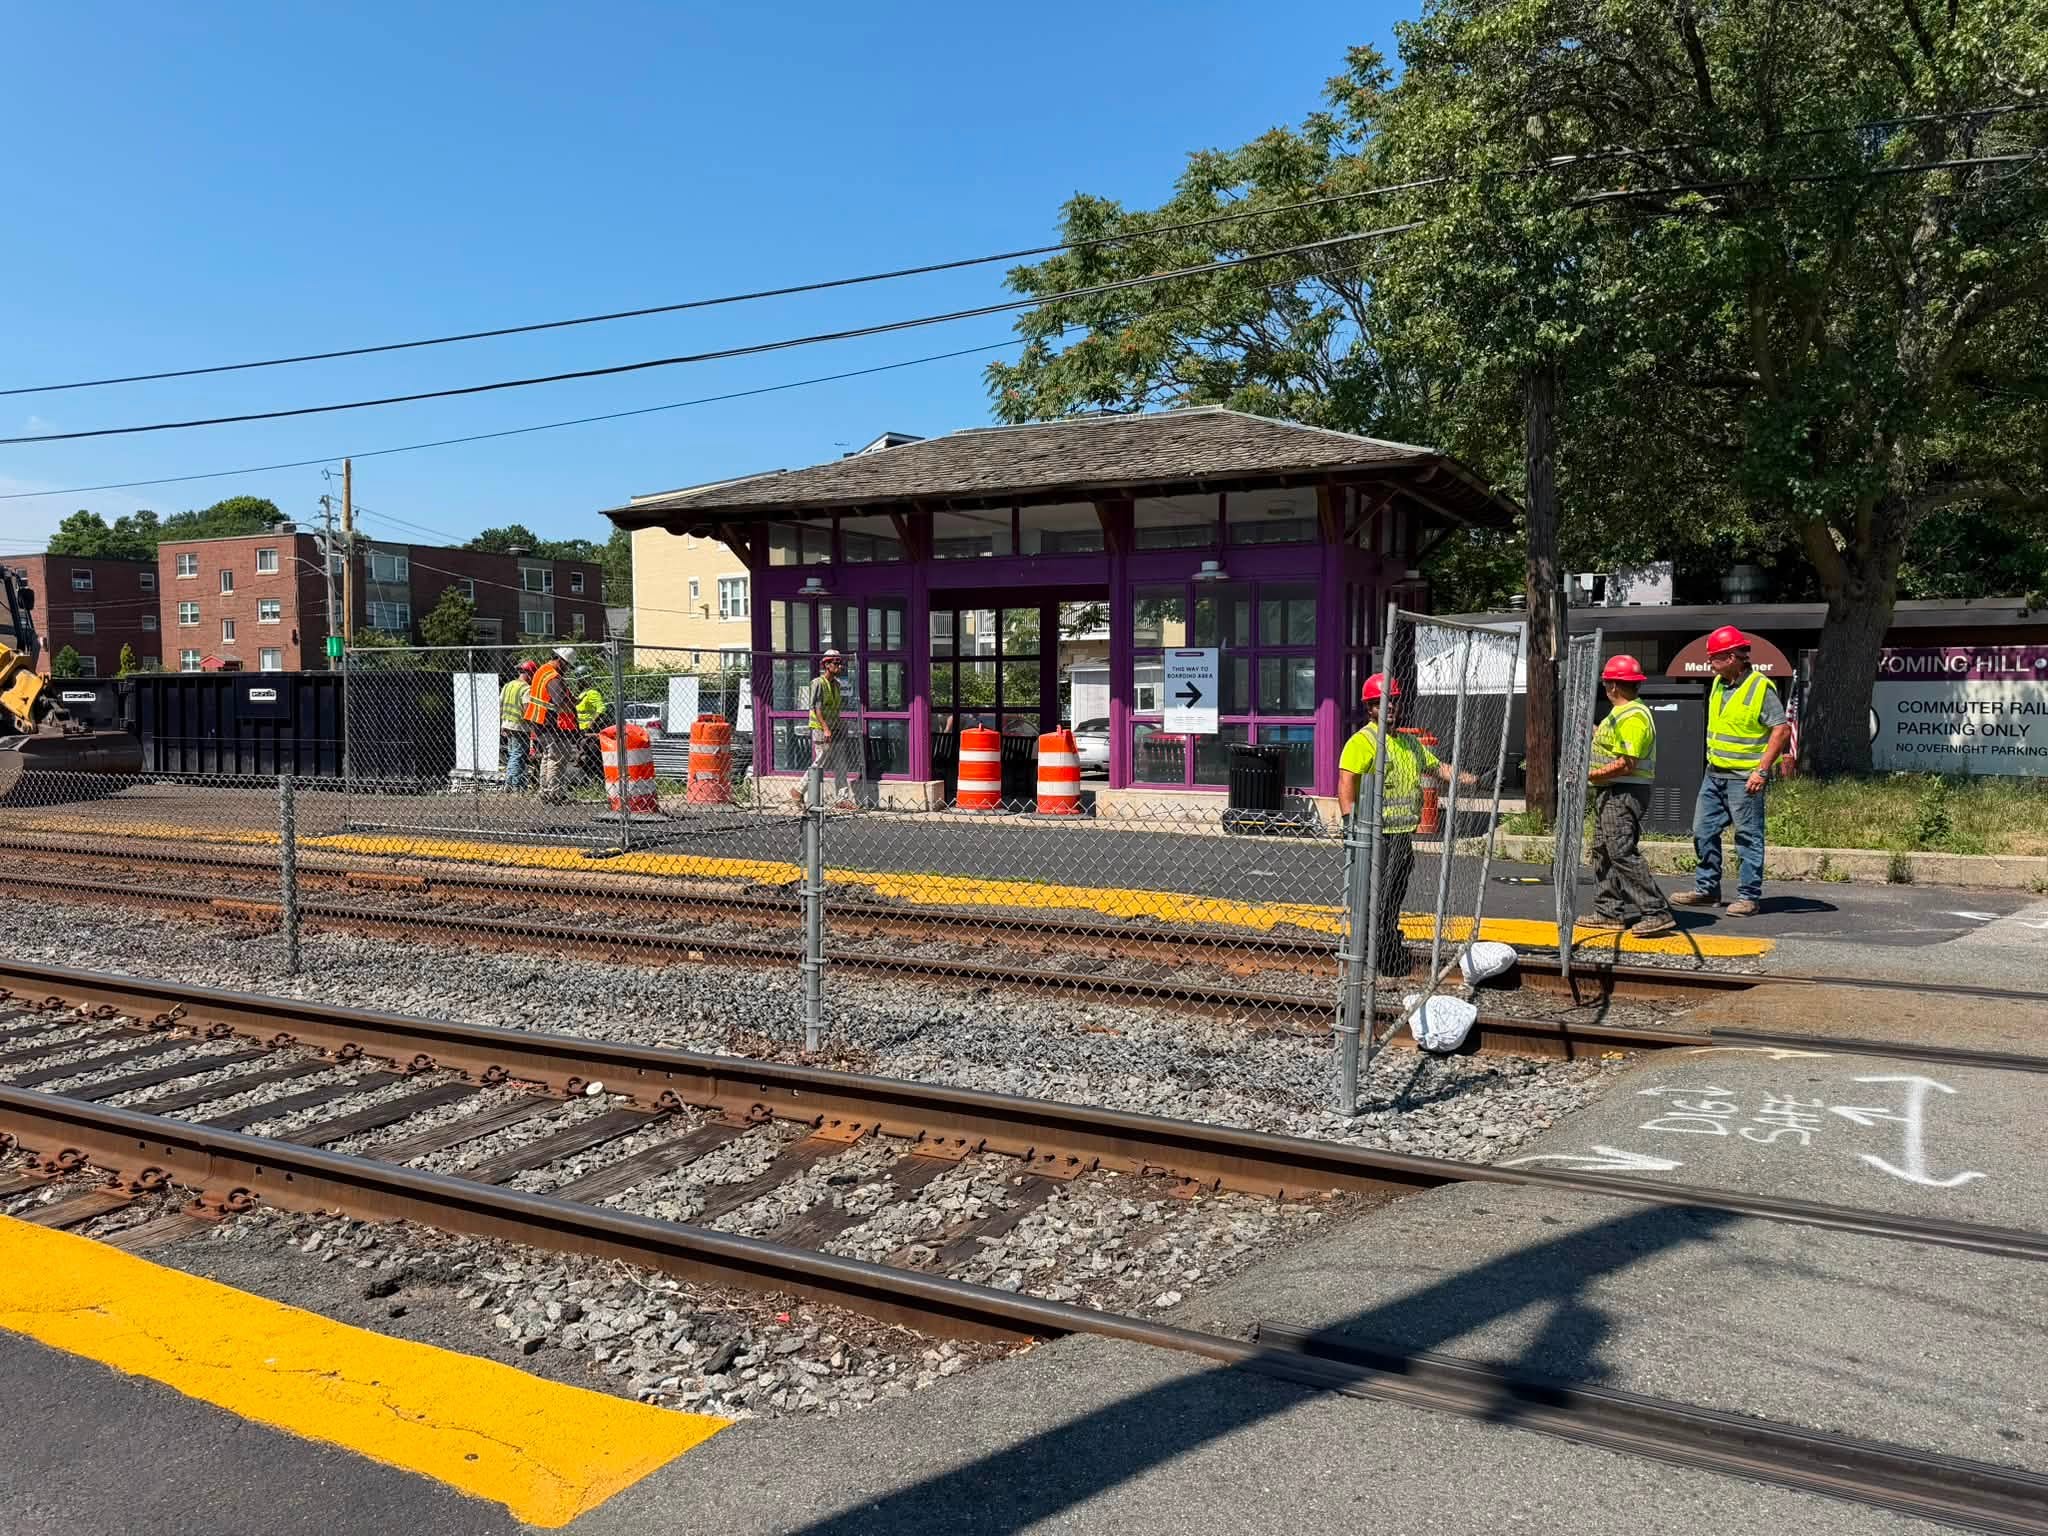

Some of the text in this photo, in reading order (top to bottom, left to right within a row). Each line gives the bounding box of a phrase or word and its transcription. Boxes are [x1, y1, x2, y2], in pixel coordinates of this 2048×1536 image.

[1877, 655, 2030, 673] YOMING HILL
[1897, 700, 2048, 715] COMMUTER RAIL
[1897, 722, 2031, 737] PARKING ONLY
[1896, 743, 2048, 756] NO OVERNIGHT PARKING
[1638, 1099, 1739, 1136] DIG
